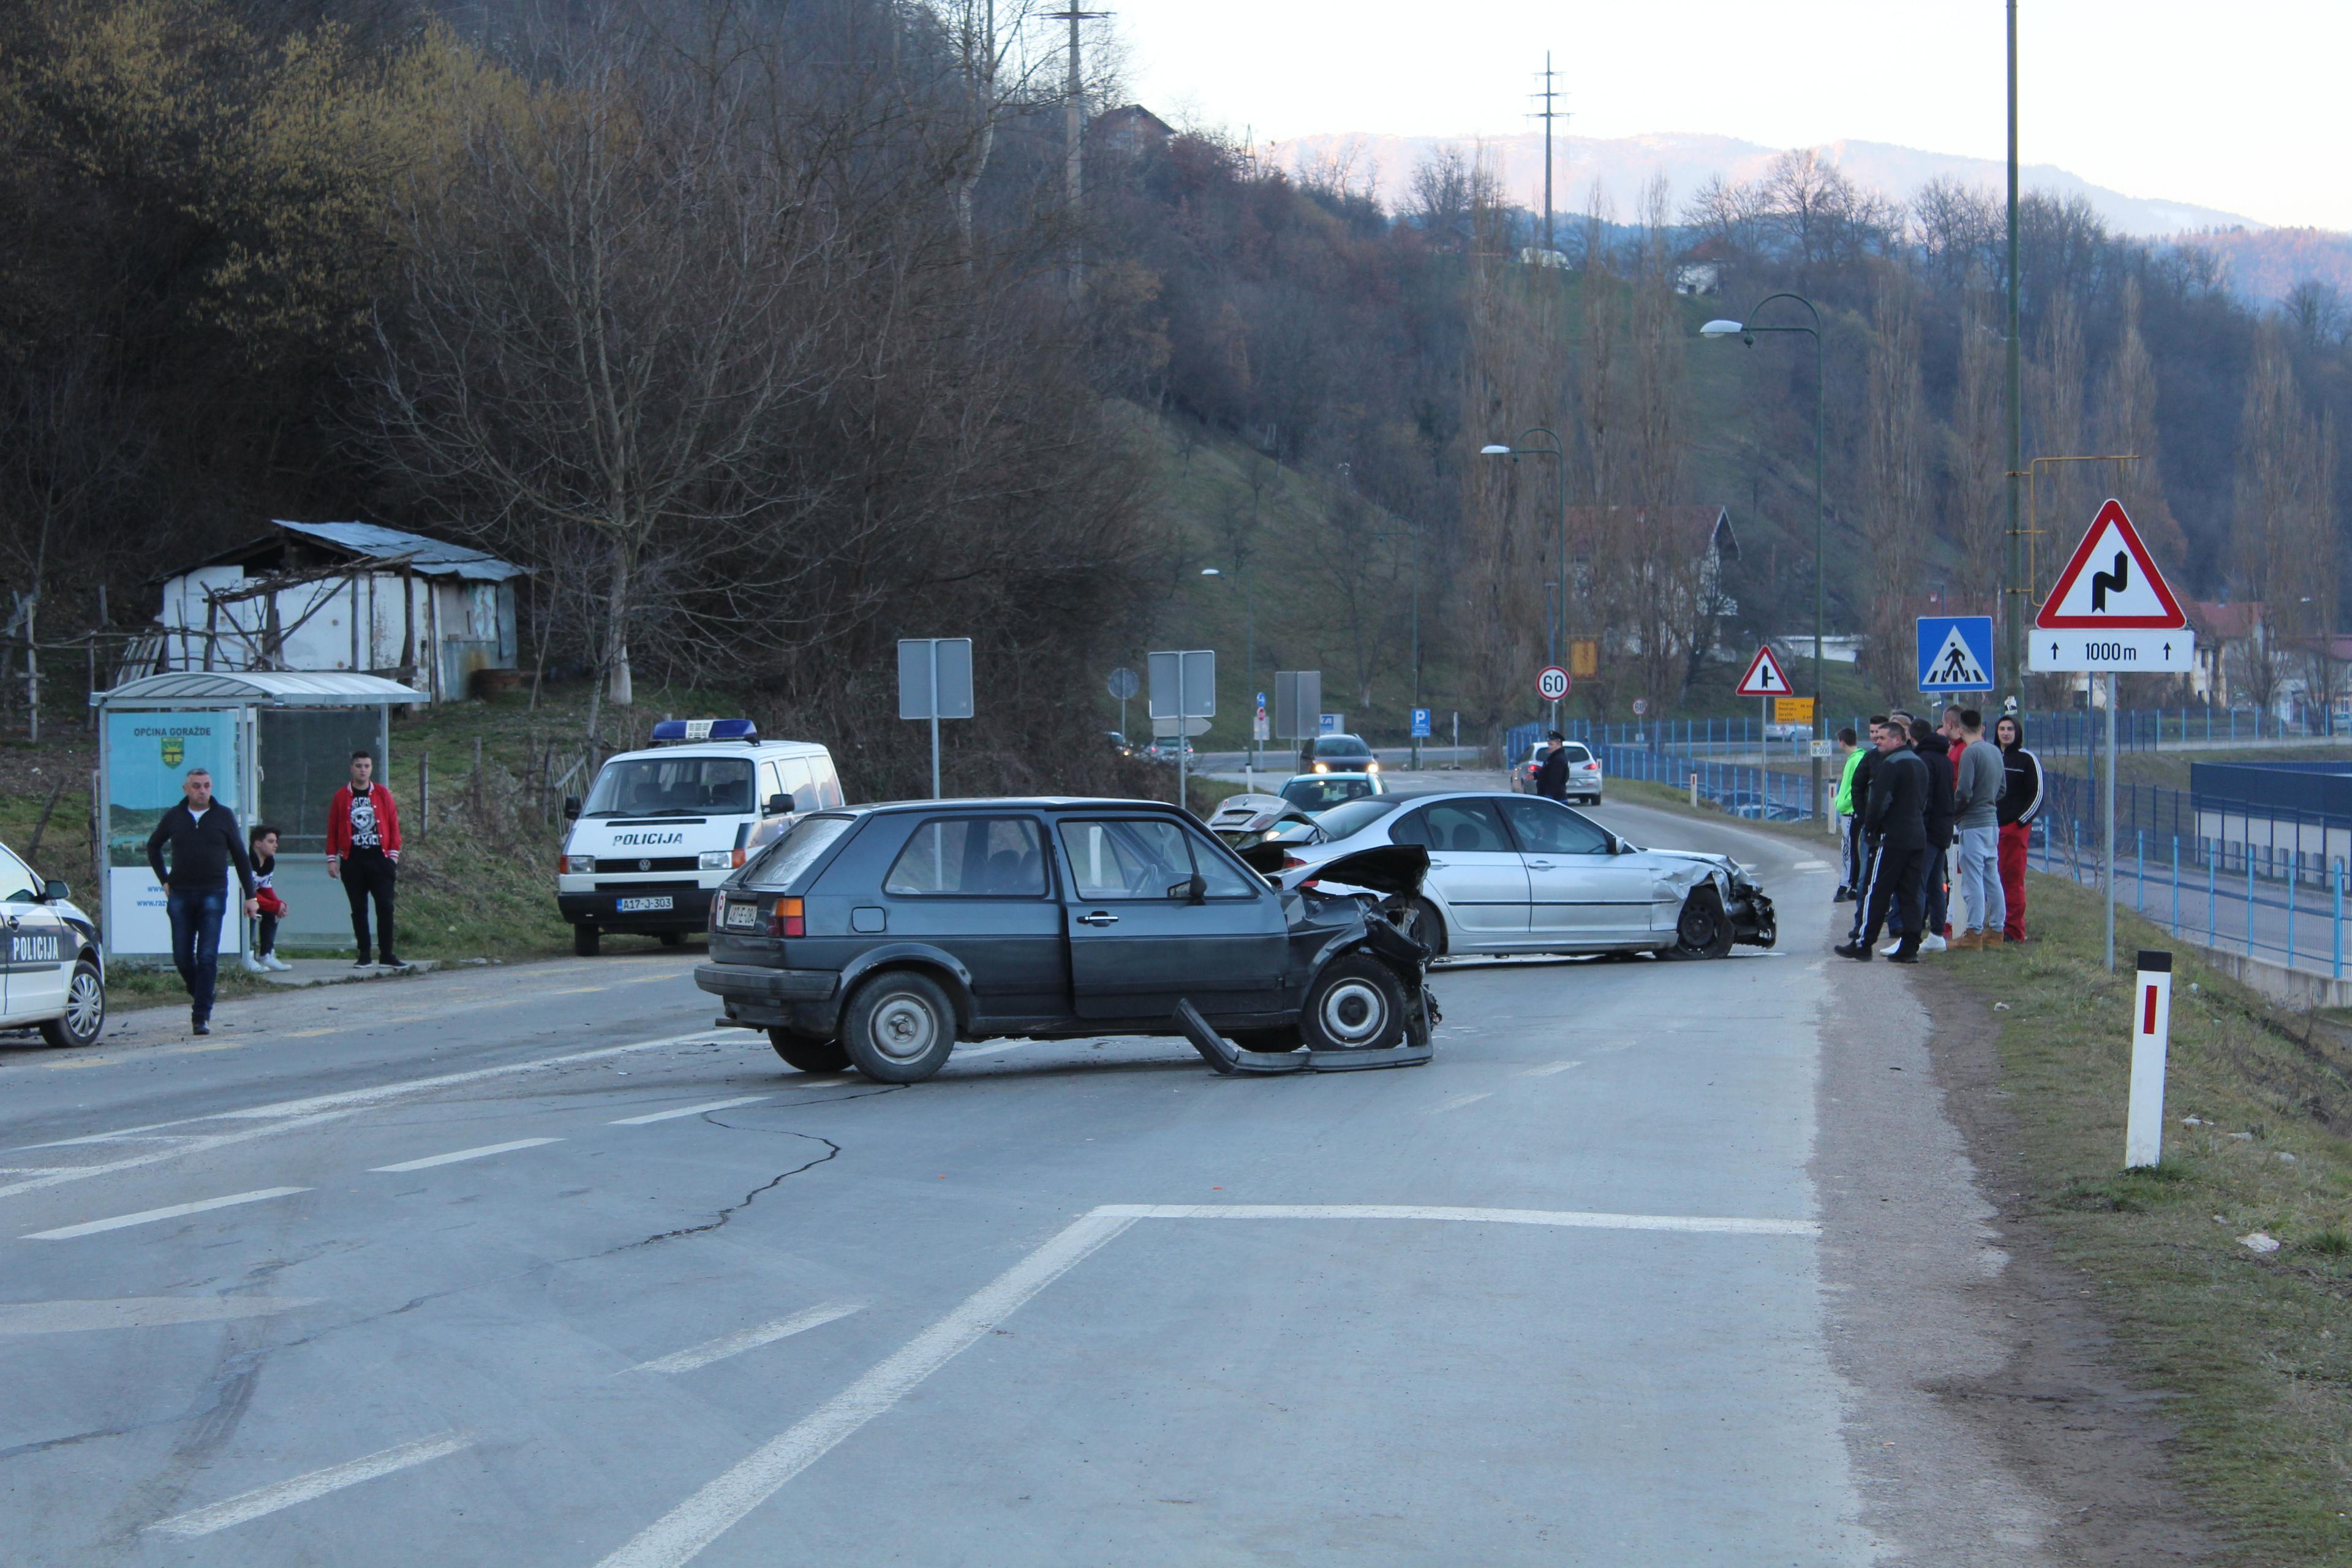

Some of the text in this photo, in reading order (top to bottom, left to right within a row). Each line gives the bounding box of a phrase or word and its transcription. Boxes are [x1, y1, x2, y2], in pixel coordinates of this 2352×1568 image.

[1544, 675, 1563, 693] 60
[1415, 710, 1426, 724] P
[170, 726, 211, 736] GORAŽDE
[612, 833, 683, 846] POLICIJA
[624, 898, 671, 909] A17-J-303
[13, 936, 59, 961] POLICIJA
